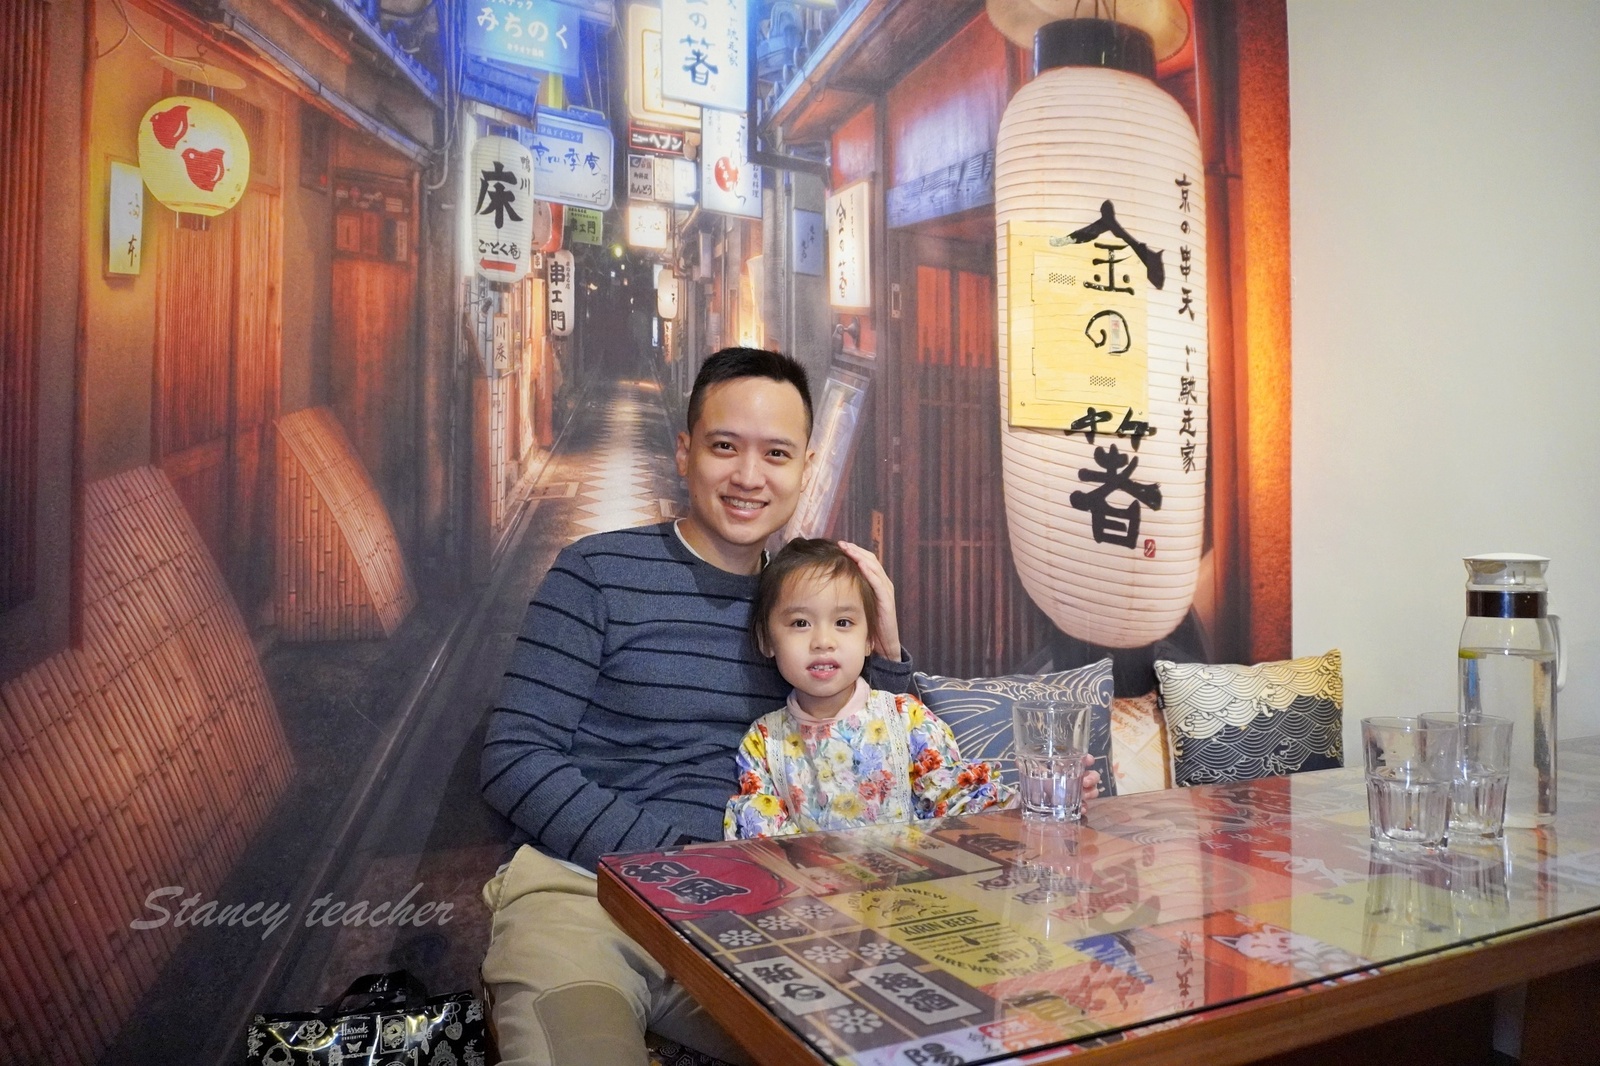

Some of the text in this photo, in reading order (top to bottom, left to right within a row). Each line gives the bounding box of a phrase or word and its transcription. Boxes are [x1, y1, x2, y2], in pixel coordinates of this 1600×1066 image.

[477, 7, 568, 49] みちのく
[474, 160, 524, 229] 床
[899, 914, 983, 936] KIRIN BEER
